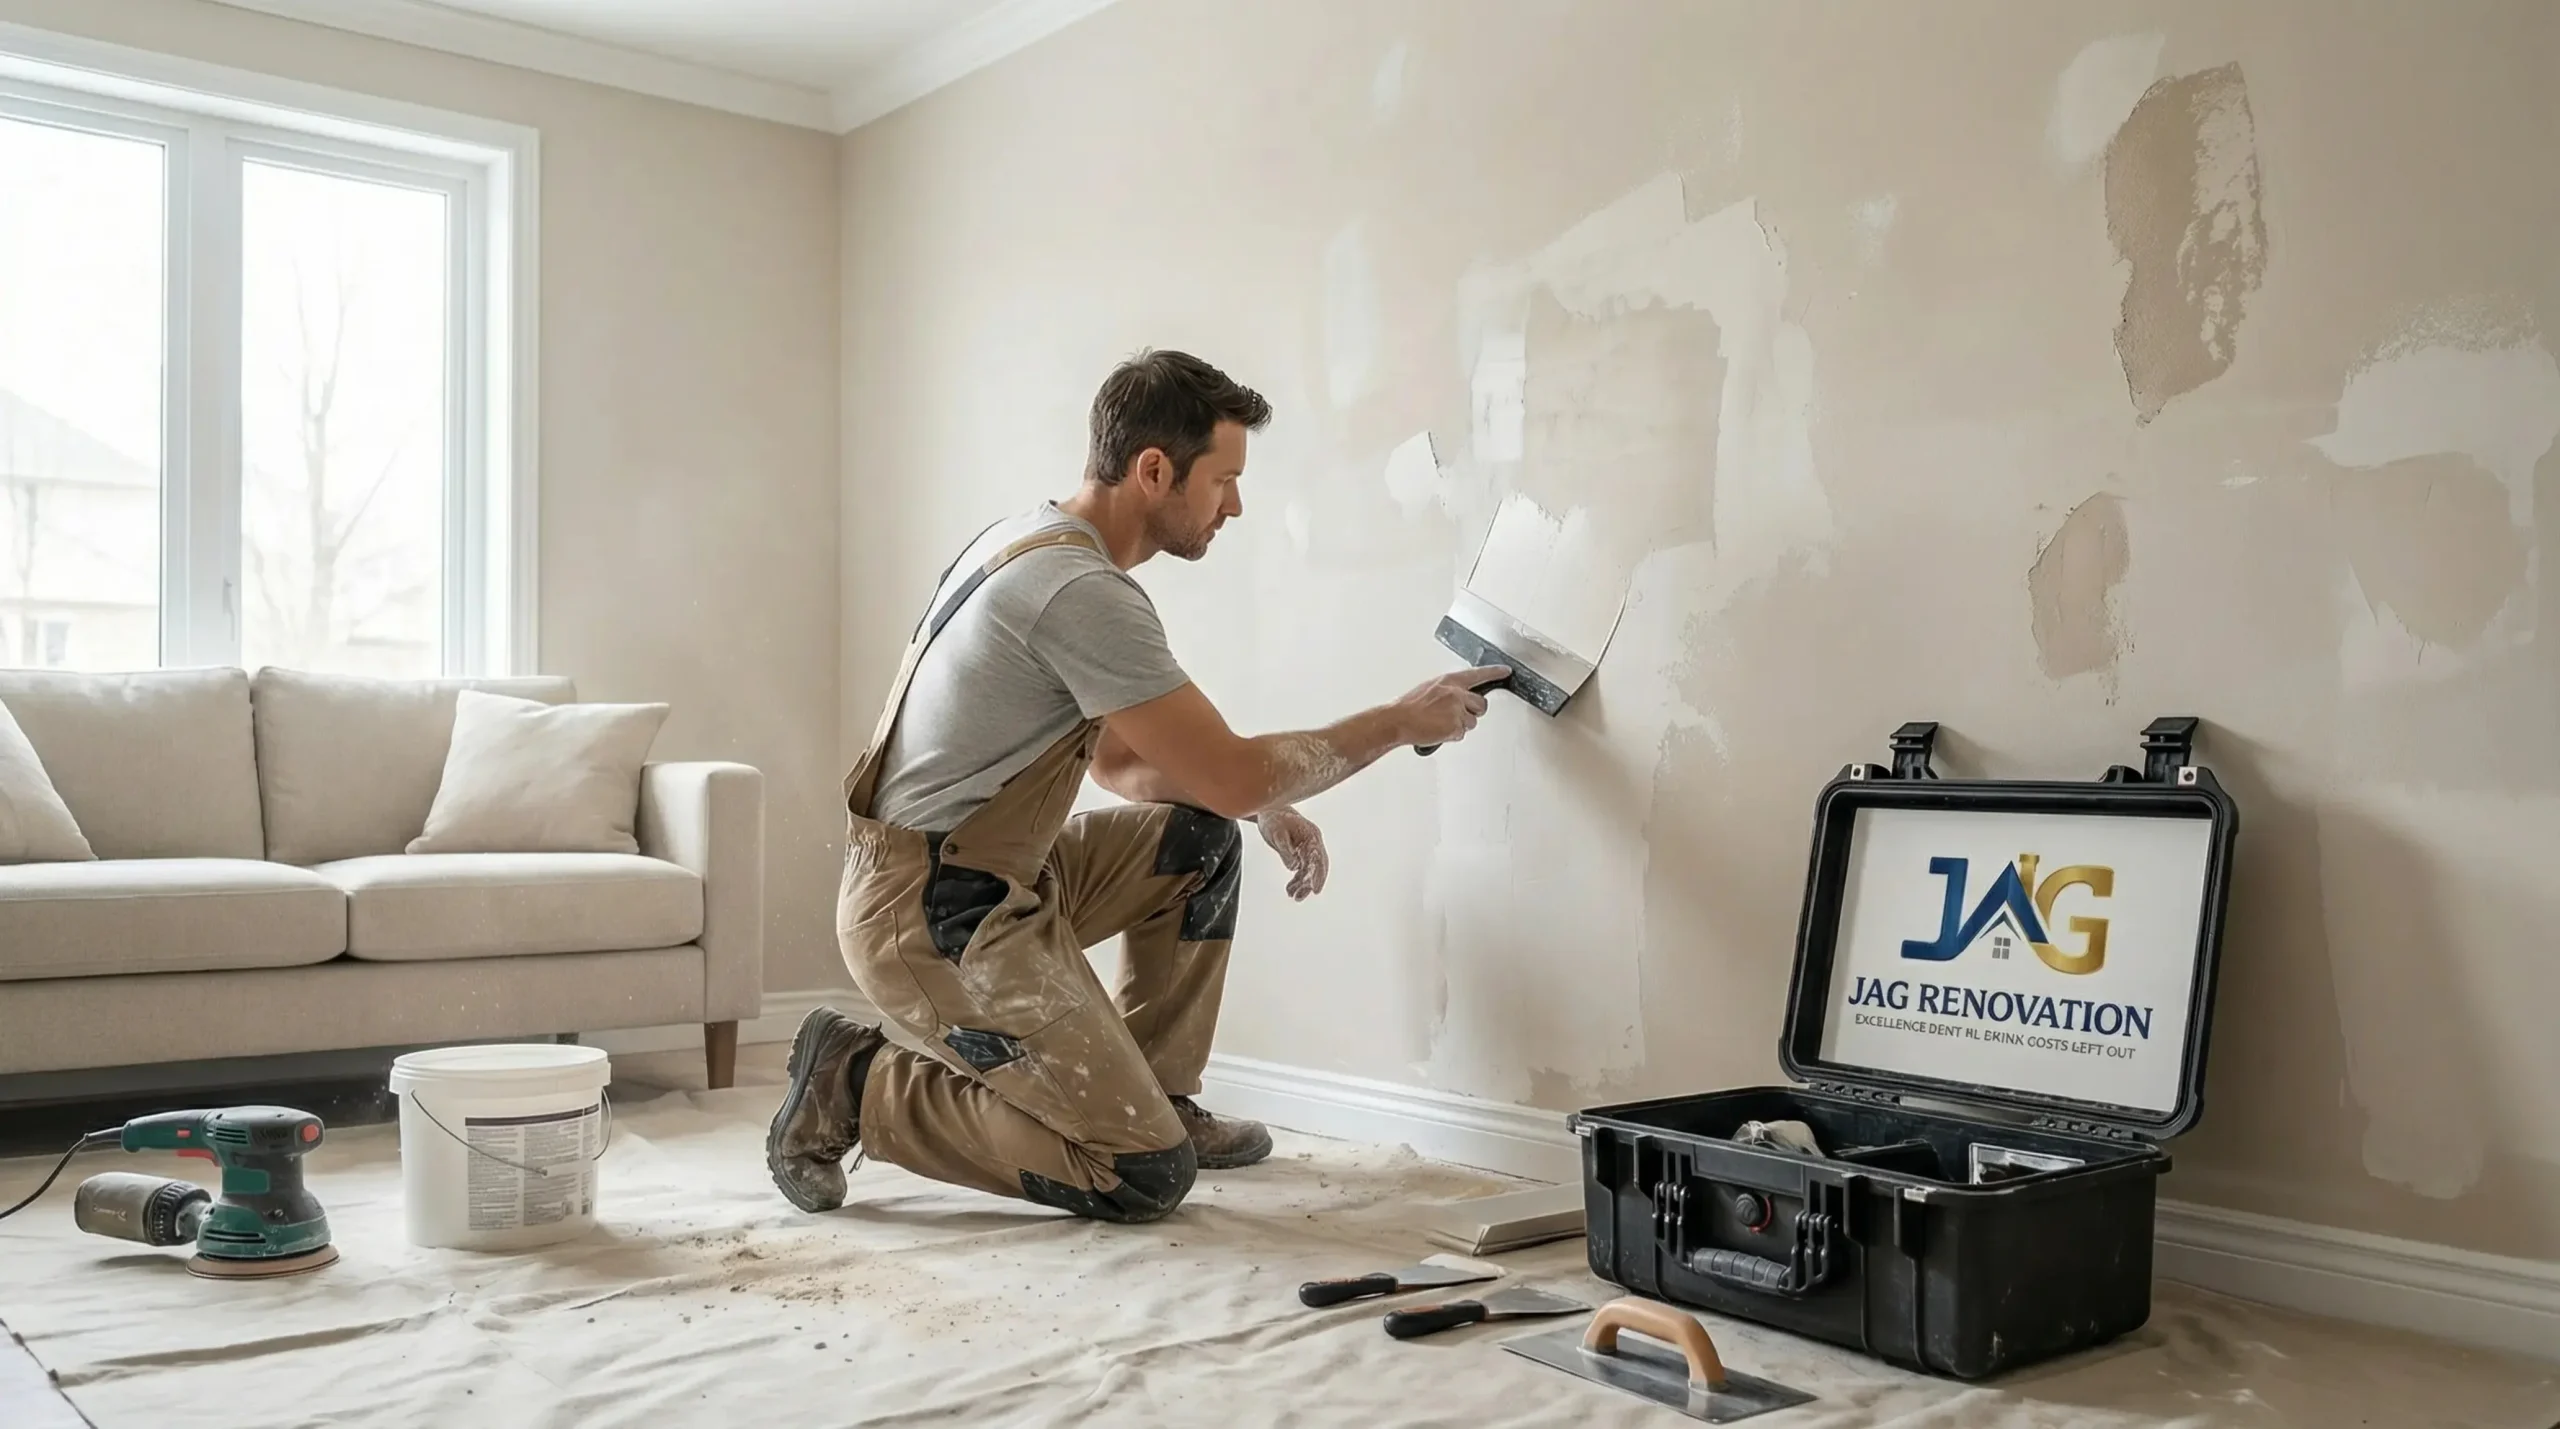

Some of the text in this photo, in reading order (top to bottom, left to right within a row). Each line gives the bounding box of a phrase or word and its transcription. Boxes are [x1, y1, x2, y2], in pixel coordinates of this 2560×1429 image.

[1848, 976, 2154, 1040] JAG RENOVATION
[1855, 1013, 1927, 1033] EXCELLENCE
[1929, 1023, 1962, 1038] DENT
[2106, 1046, 2136, 1059] OUT
